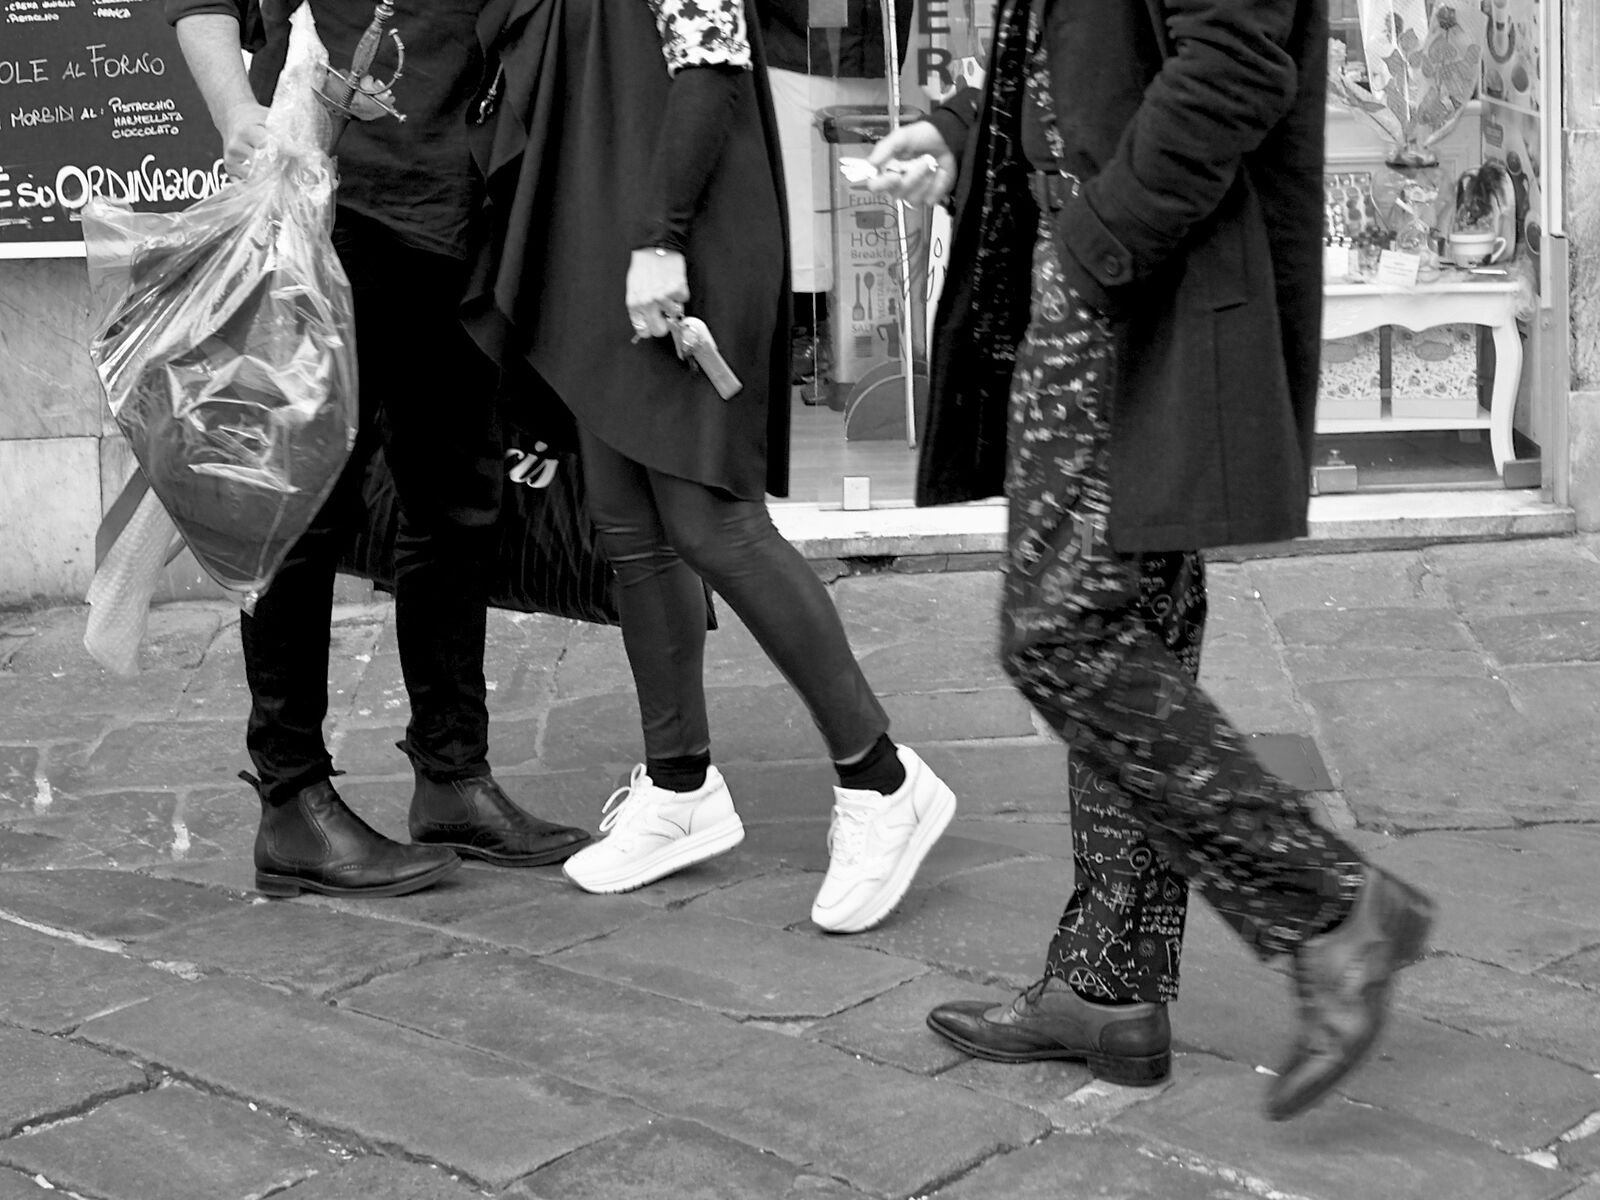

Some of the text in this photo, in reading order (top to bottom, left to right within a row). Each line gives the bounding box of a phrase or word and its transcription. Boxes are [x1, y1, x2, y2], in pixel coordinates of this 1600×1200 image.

[62, 61, 86, 79] AL
[86, 44, 164, 78] FORNO
[850, 231, 891, 248] HOT
